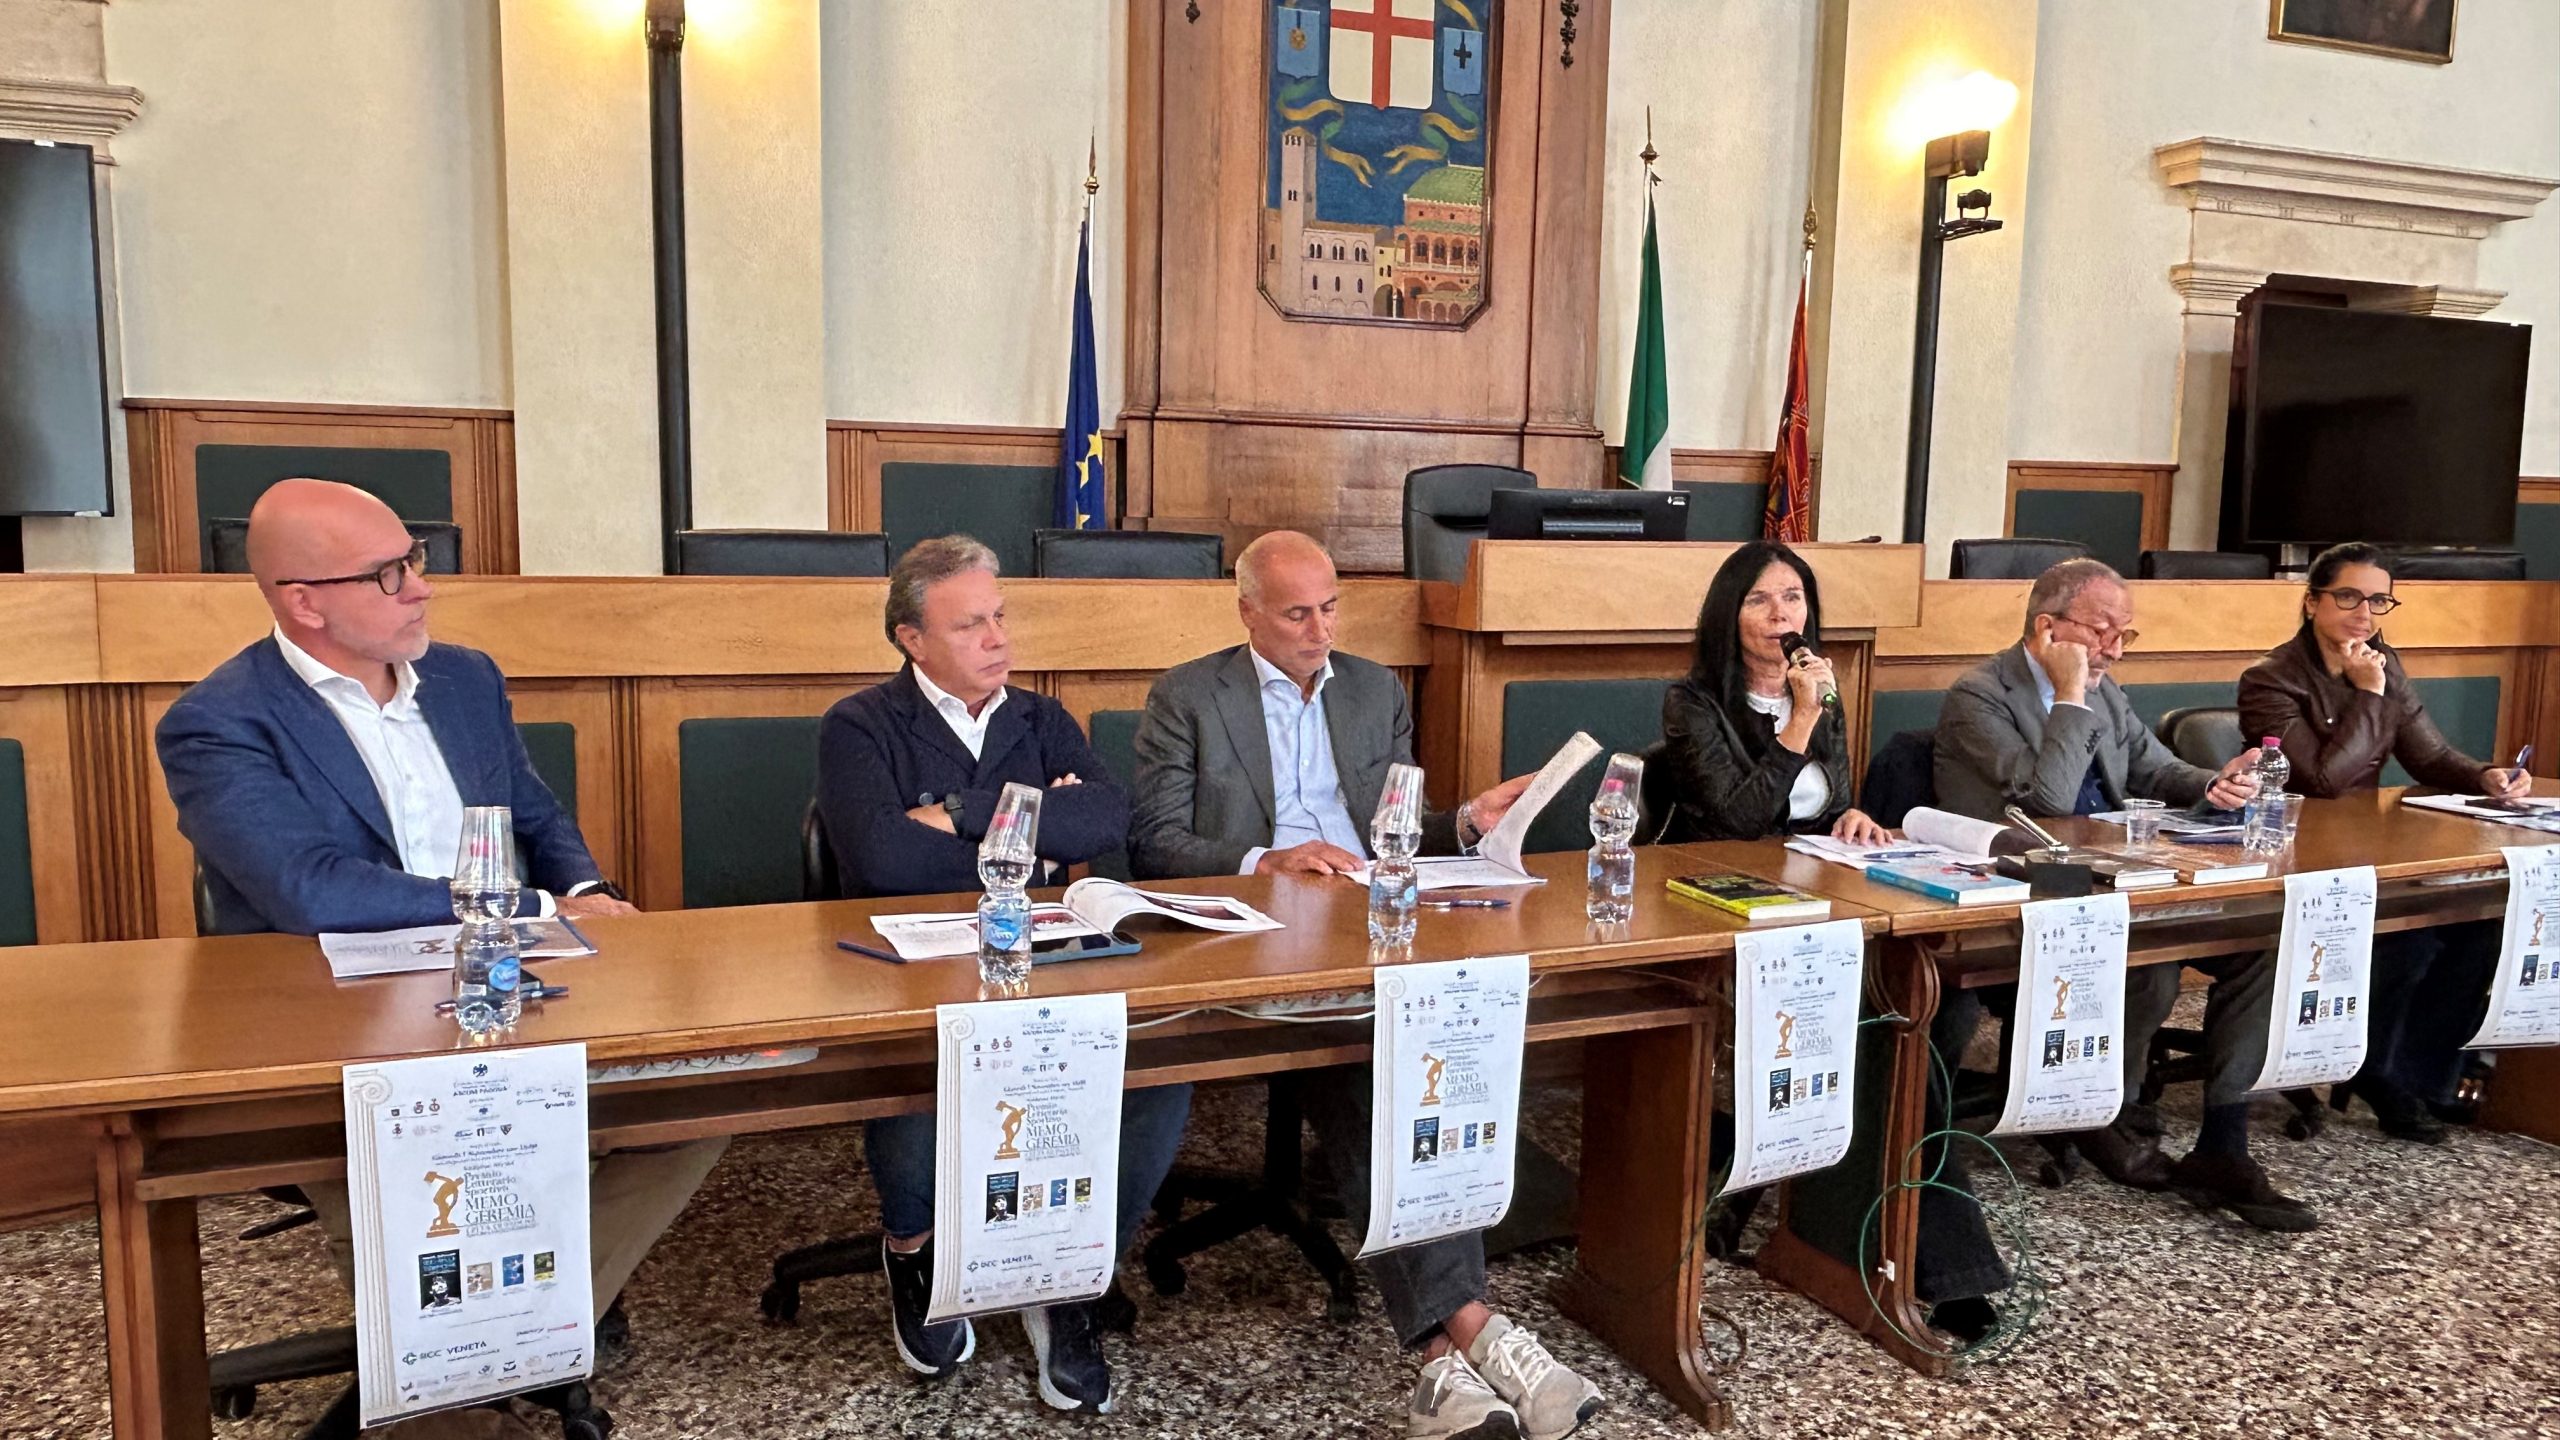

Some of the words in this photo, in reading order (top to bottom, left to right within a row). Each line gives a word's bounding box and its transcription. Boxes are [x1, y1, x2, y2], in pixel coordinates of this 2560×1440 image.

[1026, 1123, 1068, 1138] MEMO
[1026, 1133, 1080, 1149] GEREMIA
[466, 1193, 519, 1210] MEMO
[466, 1204, 535, 1224] GEREMIA
[447, 1340, 487, 1355] VENETA
